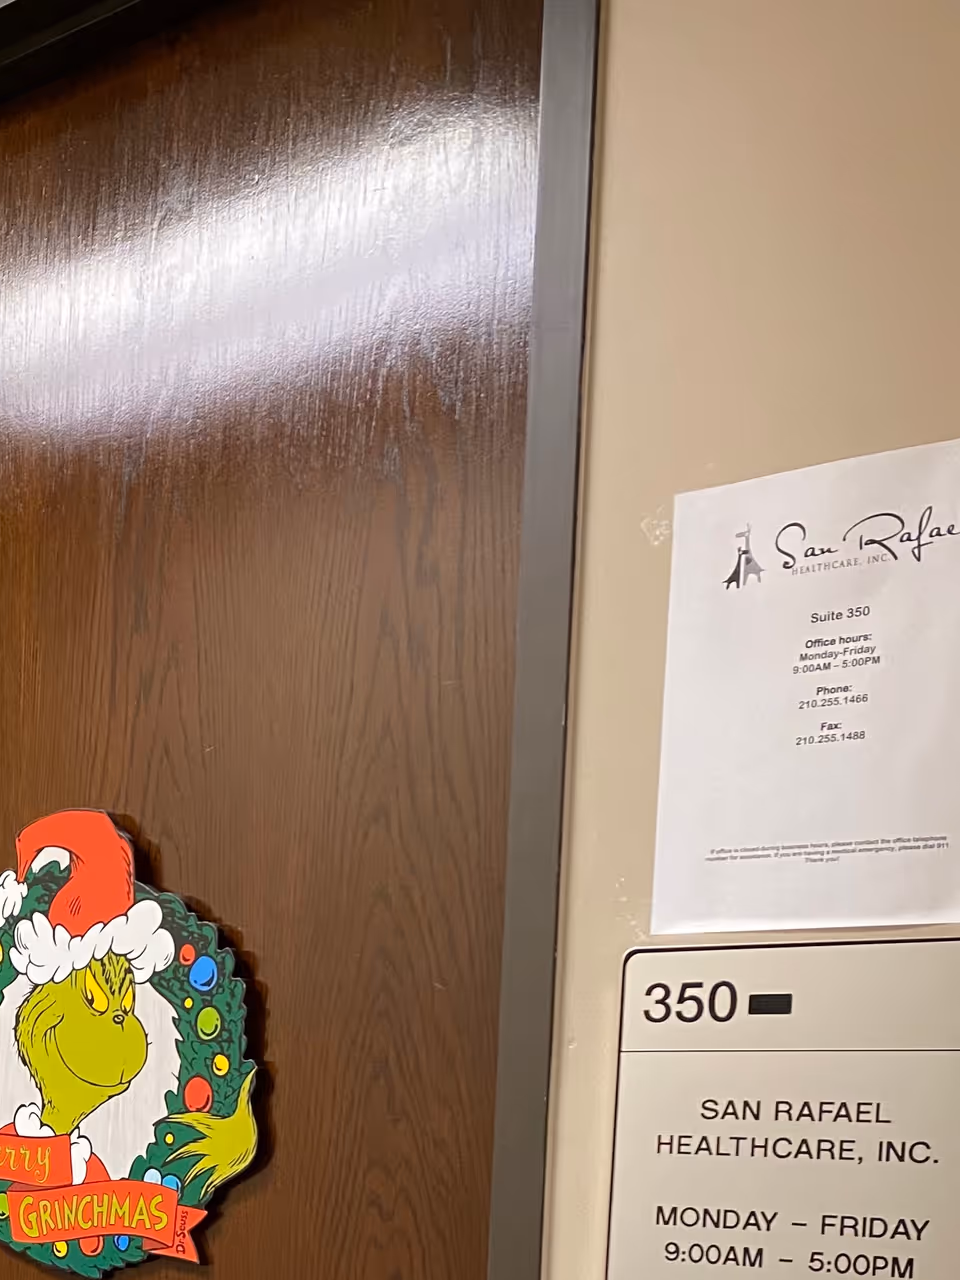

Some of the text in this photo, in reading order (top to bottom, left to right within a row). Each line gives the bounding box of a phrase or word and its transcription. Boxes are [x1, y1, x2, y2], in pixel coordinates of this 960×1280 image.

[775, 506, 960, 569] San Rafae
[791, 554, 890, 576] HEALTHCARE, INC.
[811, 606, 870, 623] Suite 350
[805, 633, 873, 649] Office hours:
[799, 645, 876, 662] Monday-Friday
[793, 662, 831, 674] 9:00AM
[842, 656, 881, 669] 5:00PM
[798, 693, 868, 709] 210.255.1466
[816, 685, 853, 695] Phone:
[820, 722, 842, 731] Fax:
[796, 731, 866, 745] 210.255.1488
[643, 981, 737, 1023] 350
[701, 1099, 892, 1124] SAN RAFAEL
[657, 1134, 939, 1164] HEALTHCARE, INC.
[19, 1190, 169, 1238] GRINCHMAS
[175, 1210, 188, 1239] Seuss
[655, 1206, 778, 1232] MONDAY
[820, 1215, 930, 1241] FRIDAY
[664, 1242, 763, 1268] 9:00AM
[808, 1252, 914, 1279] 5:00PM
